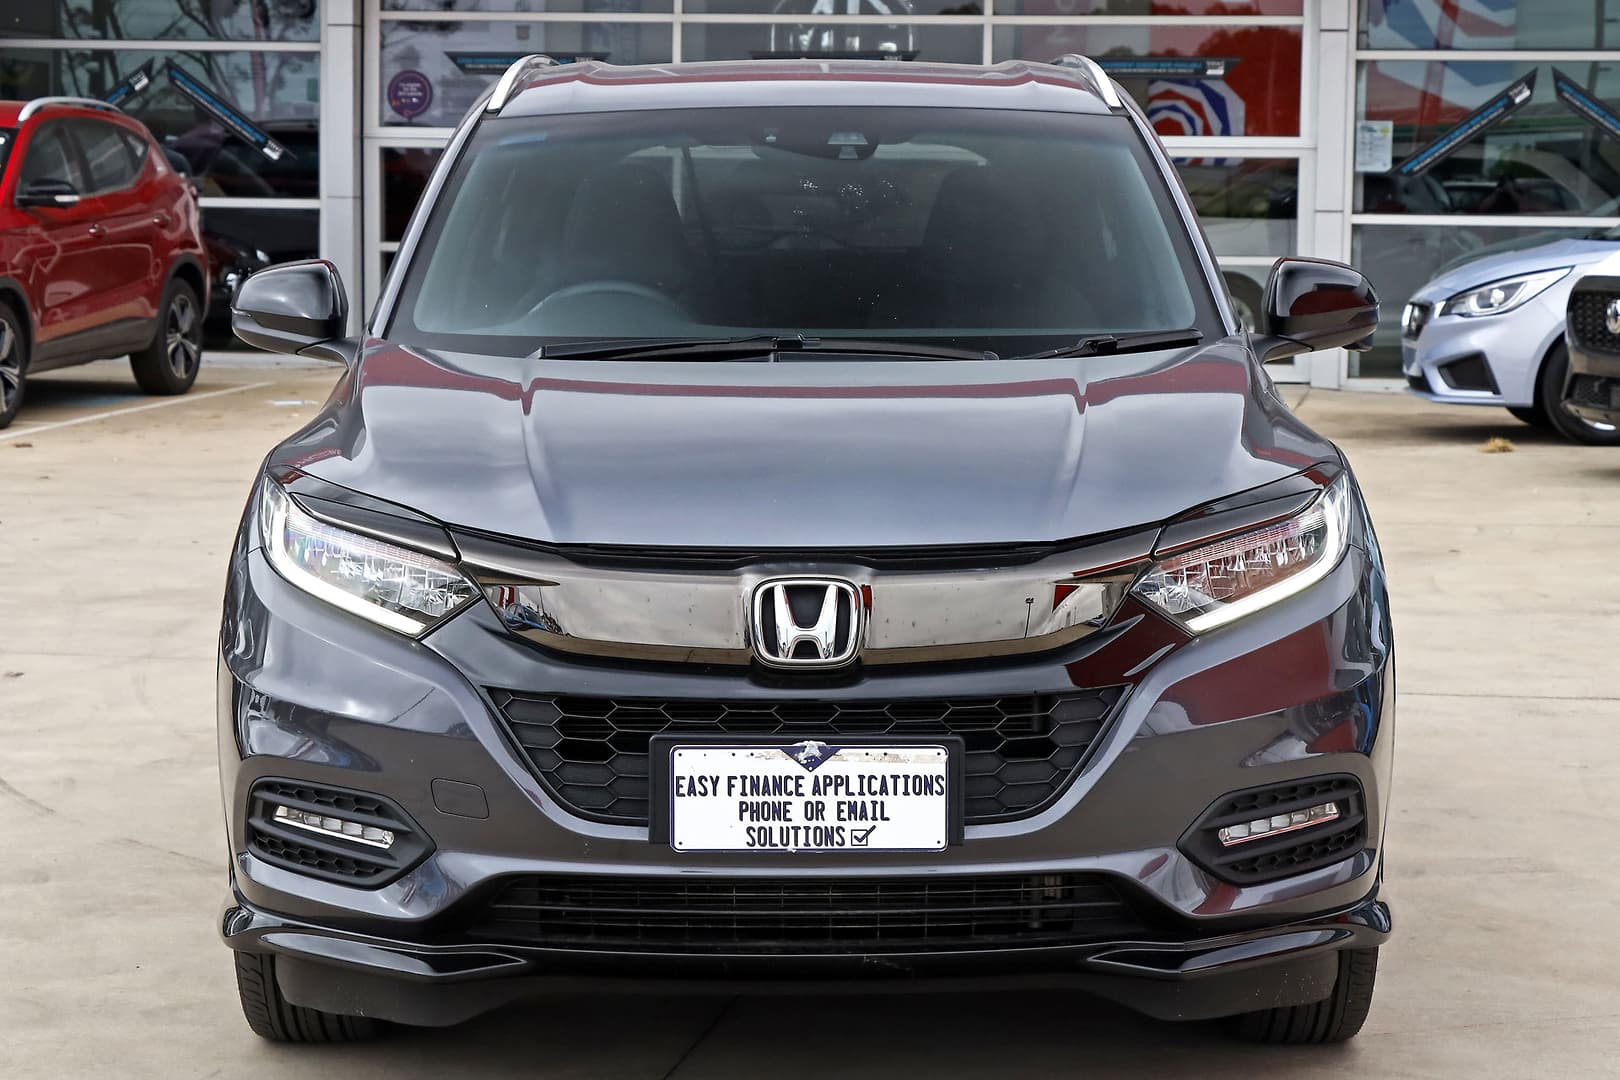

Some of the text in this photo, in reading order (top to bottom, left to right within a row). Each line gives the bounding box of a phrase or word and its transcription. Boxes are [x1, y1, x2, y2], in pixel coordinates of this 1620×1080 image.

[675, 773, 946, 798] EASY FINANCE APPLICATIONS
[738, 800, 891, 823] PHONE OR EMAIL
[745, 825, 846, 848] SOLUTIONS
